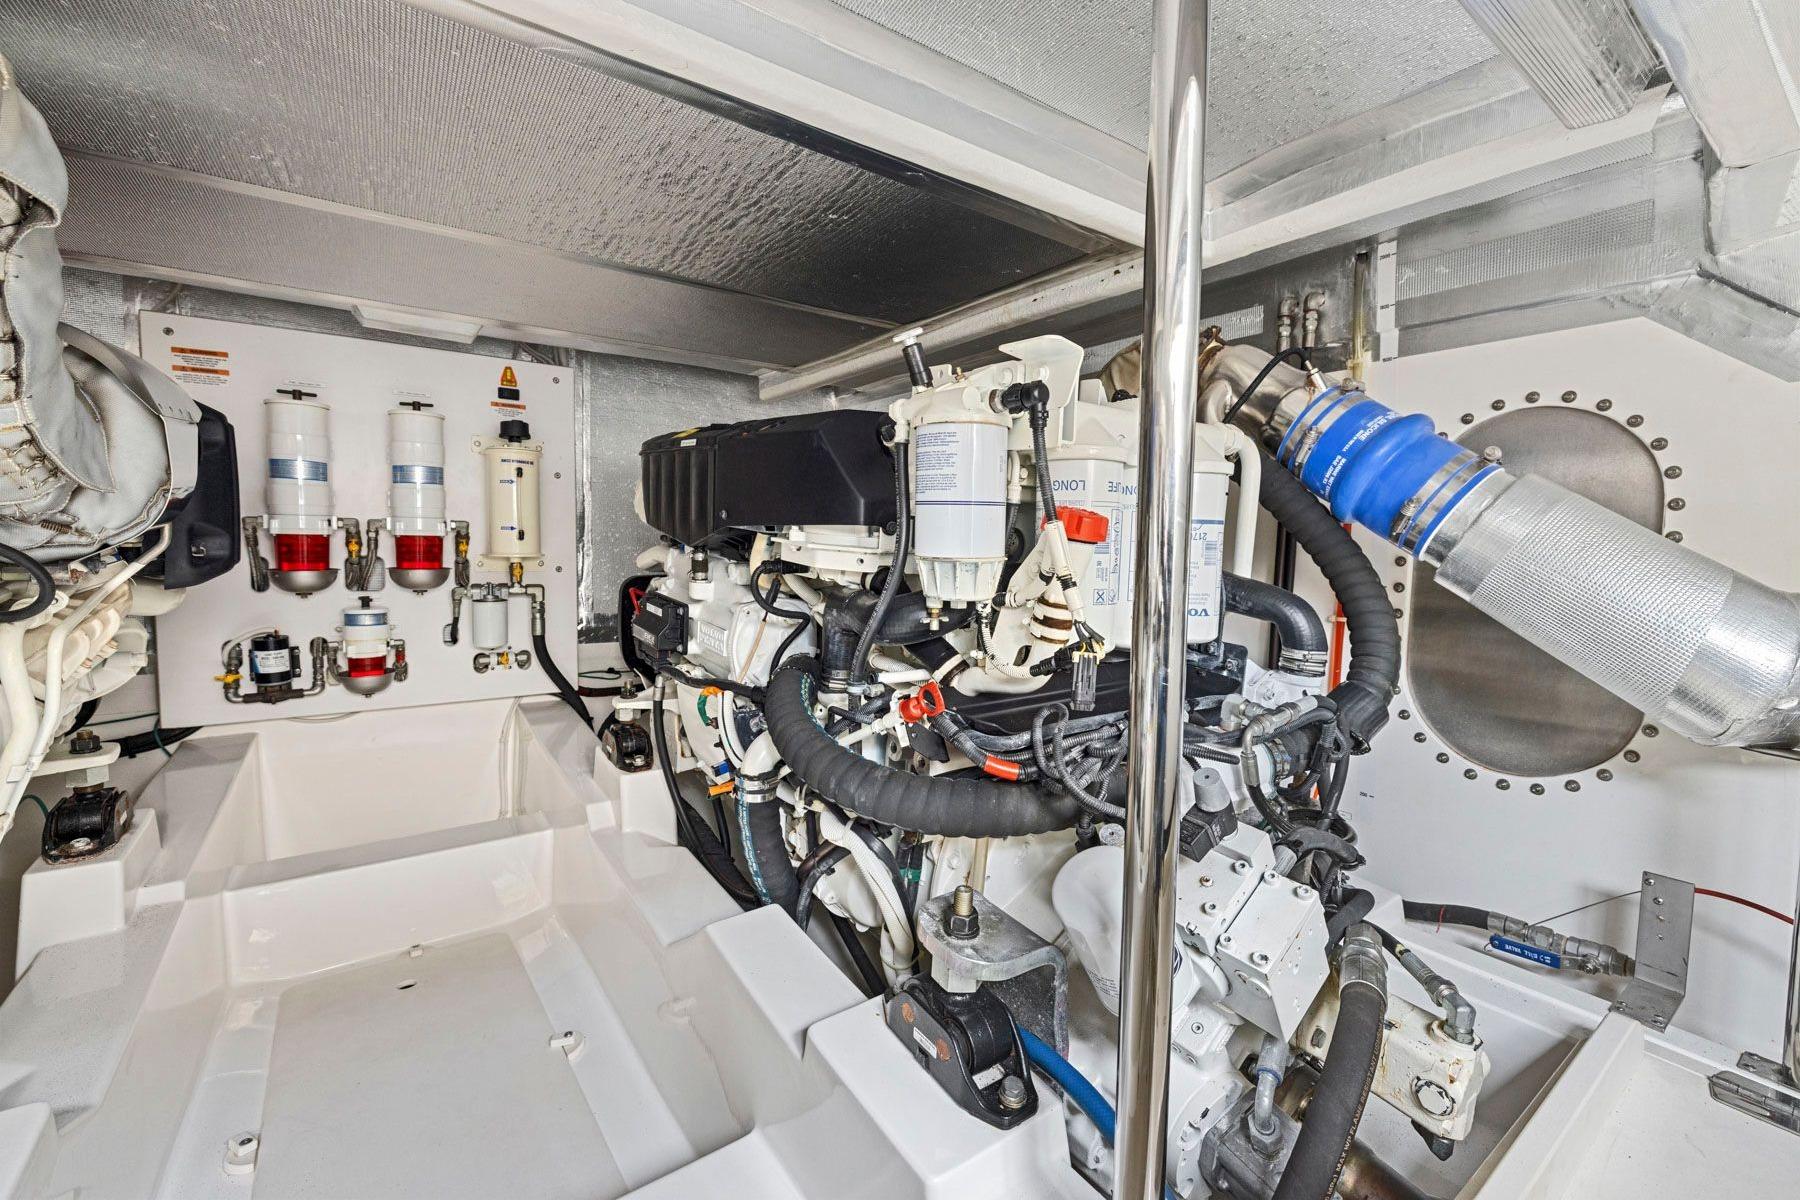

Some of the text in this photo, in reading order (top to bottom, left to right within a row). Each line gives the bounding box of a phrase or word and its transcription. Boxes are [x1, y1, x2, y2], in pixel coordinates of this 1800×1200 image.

[1053, 479, 1086, 491] LONG
[1191, 532, 1207, 541] 217
[1335, 1152, 1348, 1172] MAX
[1349, 1104, 1364, 1135] FLAME
[1359, 1056, 1378, 1104] RESISTANT
